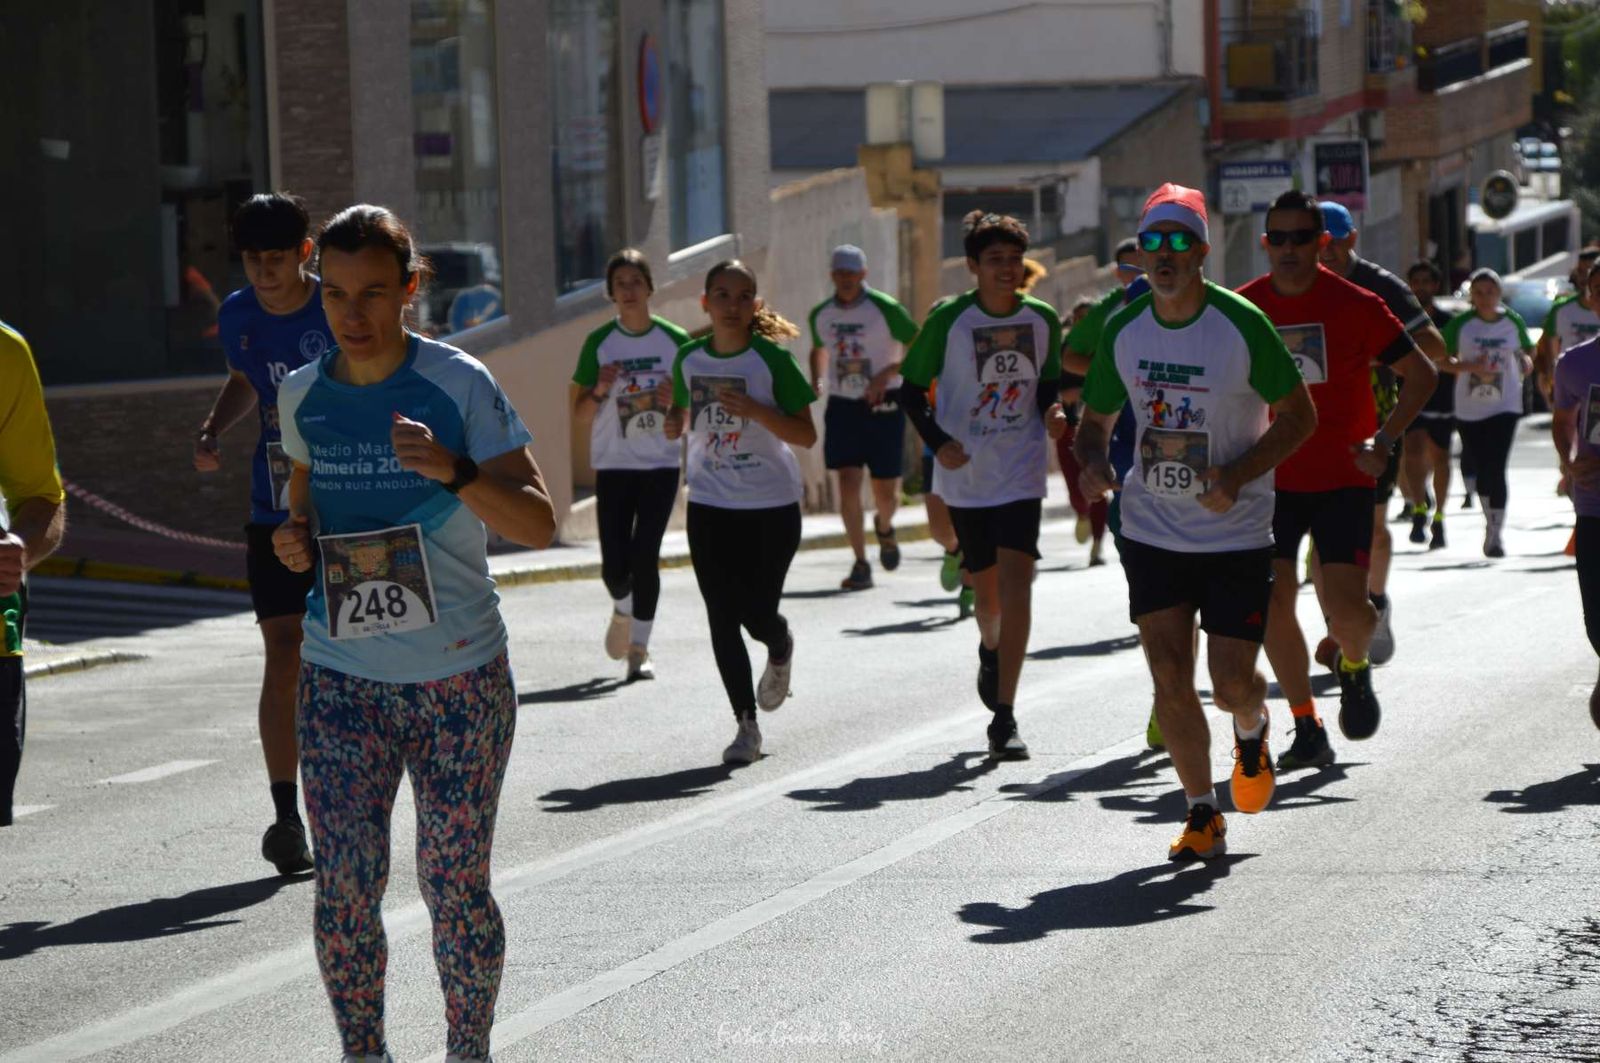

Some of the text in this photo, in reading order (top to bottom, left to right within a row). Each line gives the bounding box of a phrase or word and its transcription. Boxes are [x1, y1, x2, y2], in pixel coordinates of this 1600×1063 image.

[995, 354, 1018, 373] 82
[636, 413, 656, 429] 48
[312, 443, 352, 457] Medio
[312, 457, 374, 475] Almería
[345, 479, 372, 491] RUIZ
[1153, 465, 1192, 489] 159
[347, 584, 407, 624] 248
